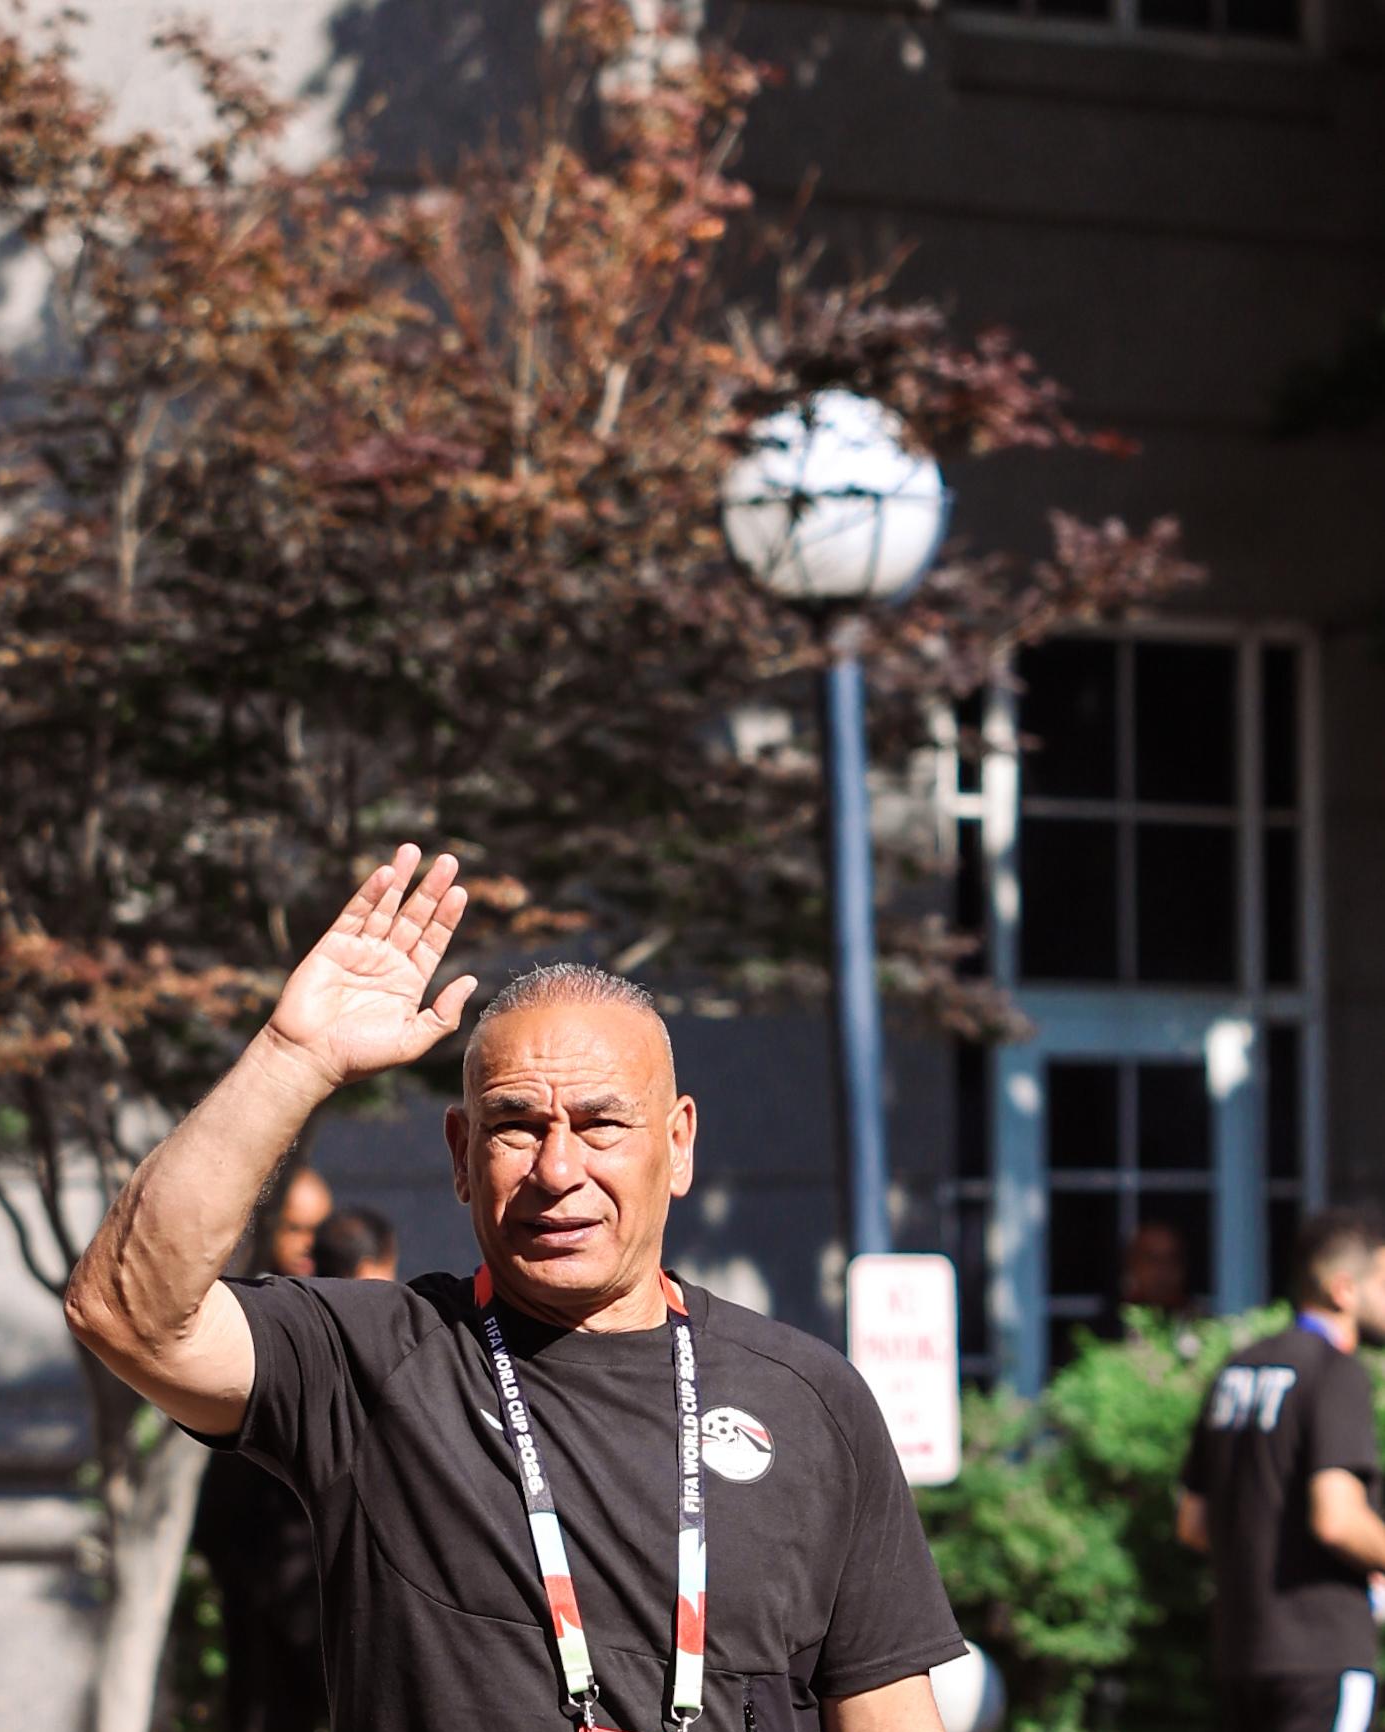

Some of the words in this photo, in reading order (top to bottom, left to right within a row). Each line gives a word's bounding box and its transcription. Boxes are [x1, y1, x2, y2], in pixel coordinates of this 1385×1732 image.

[484, 1316, 503, 1348] FIFA
[493, 1346, 520, 1400] WORLD
[681, 1380, 698, 1413] CUP
[507, 1400, 529, 1433] CUP
[683, 1414, 699, 1475] WORLD
[683, 1477, 700, 1513] FIFA
